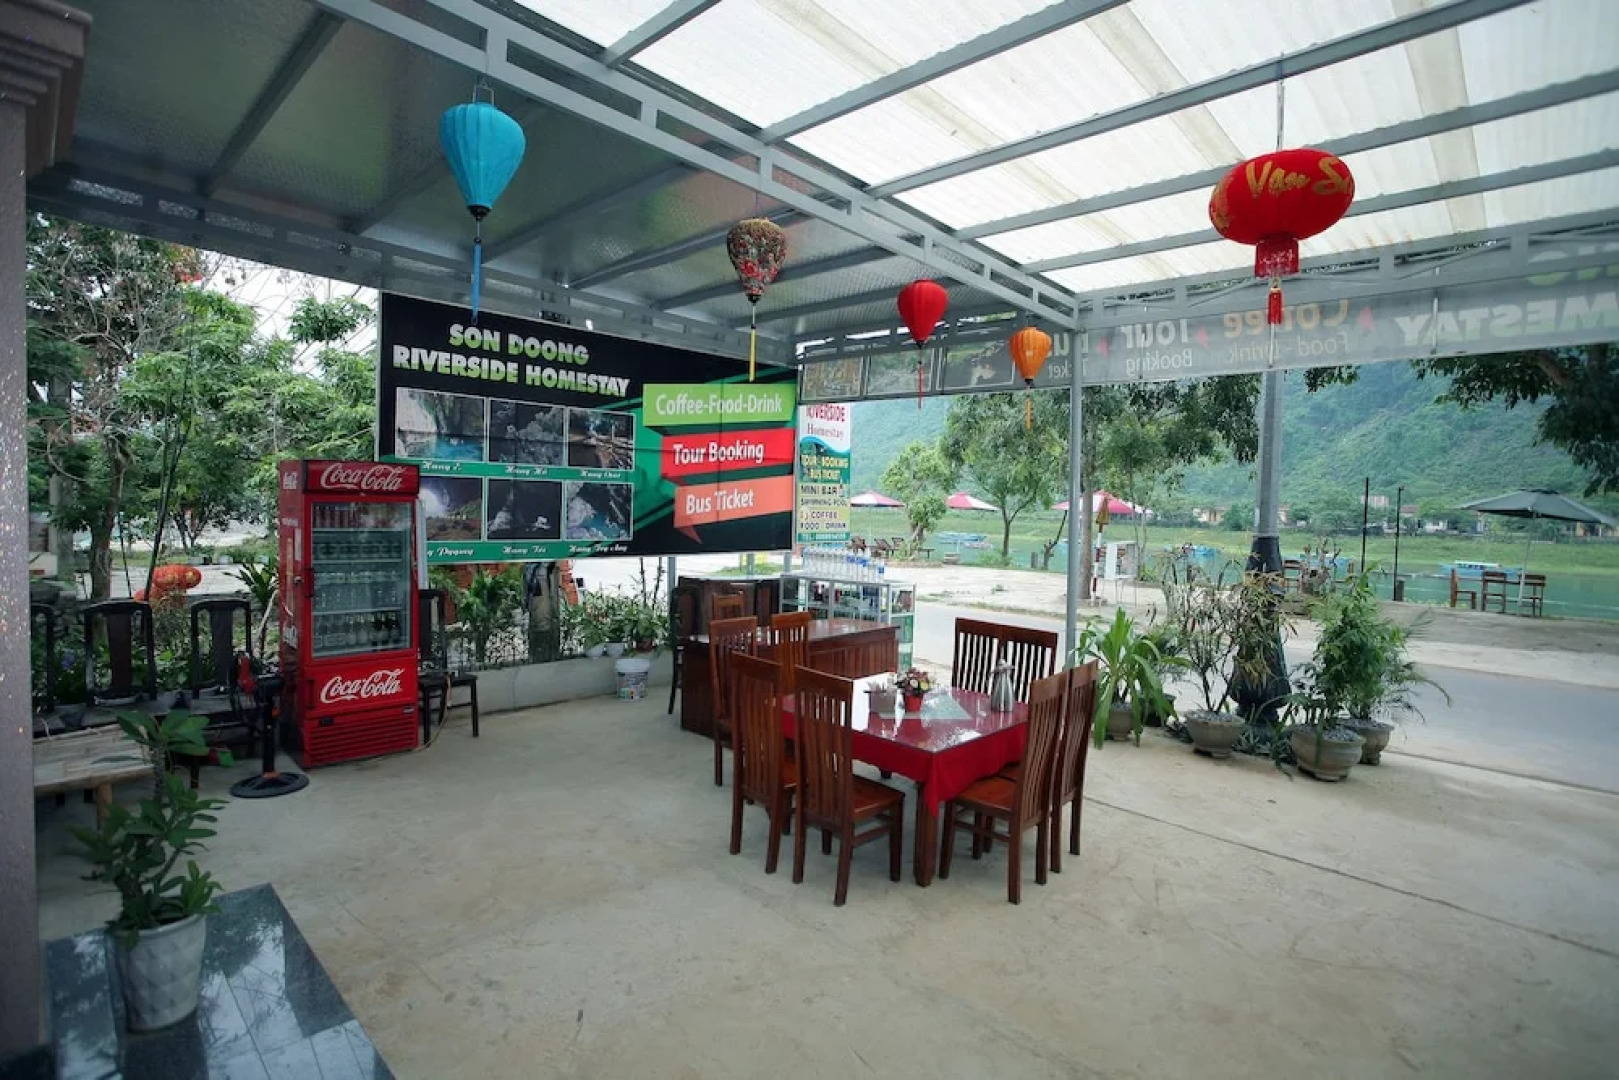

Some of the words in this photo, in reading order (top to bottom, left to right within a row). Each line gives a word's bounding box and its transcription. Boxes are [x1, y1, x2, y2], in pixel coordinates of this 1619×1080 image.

[449, 323, 501, 351] SON
[507, 333, 590, 365] DOONG
[393, 344, 519, 383] RIVERSIDE
[525, 364, 630, 398] HOMESTAY
[656, 394, 782, 415] Coffee-Food-Drink
[673, 443, 707, 465] Tour
[708, 440, 764, 464] Booking
[320, 462, 407, 491] Coca-Cola
[685, 493, 712, 515] Bus
[714, 490, 754, 511] Ticket
[810, 511, 838, 519] COFFEE
[320, 668, 406, 703] Coca-Cola
